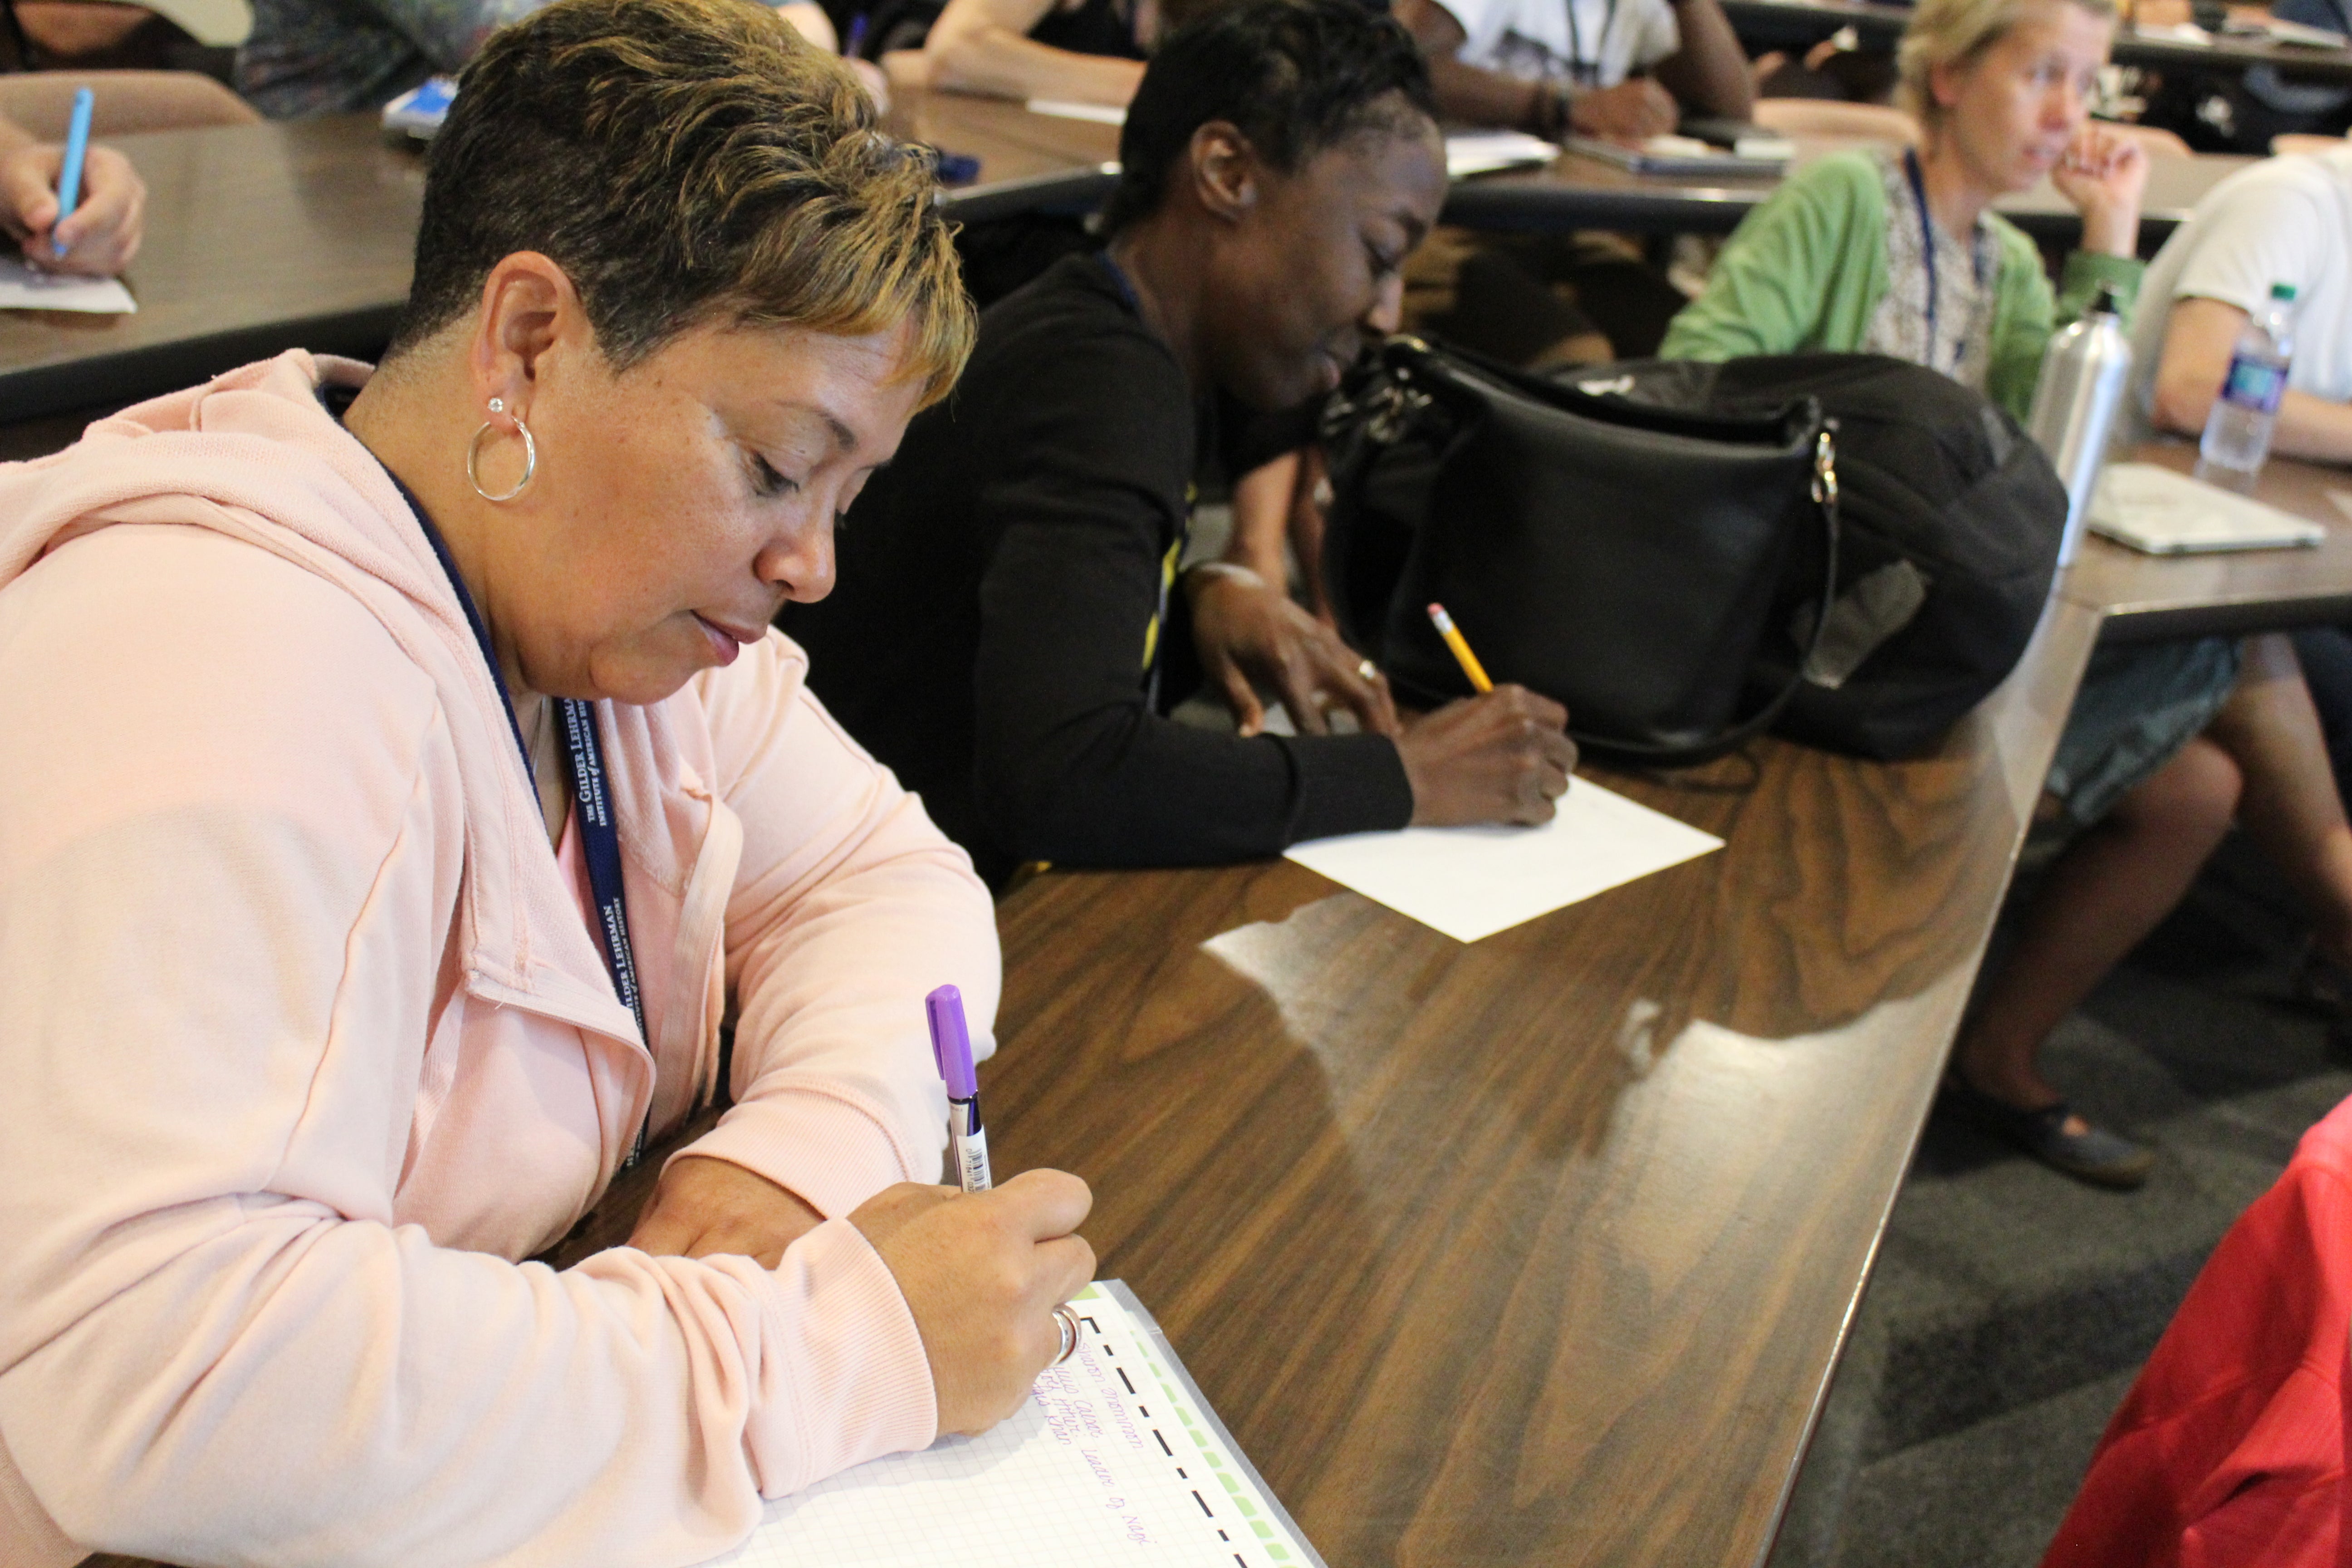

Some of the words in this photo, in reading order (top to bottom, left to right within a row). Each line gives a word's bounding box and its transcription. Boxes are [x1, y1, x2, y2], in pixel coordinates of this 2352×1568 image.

[564, 699, 583, 750] LEHRMA
[581, 719, 597, 766] AMERICAN
[574, 752, 593, 803] GILDER
[587, 767, 600, 776] of
[586, 804, 595, 823] THE
[592, 777, 608, 827] INSTITUTE
[603, 905, 626, 970] LEHRMAN
[613, 897, 625, 936] HISTORY
[620, 971, 633, 1009] ILDER
